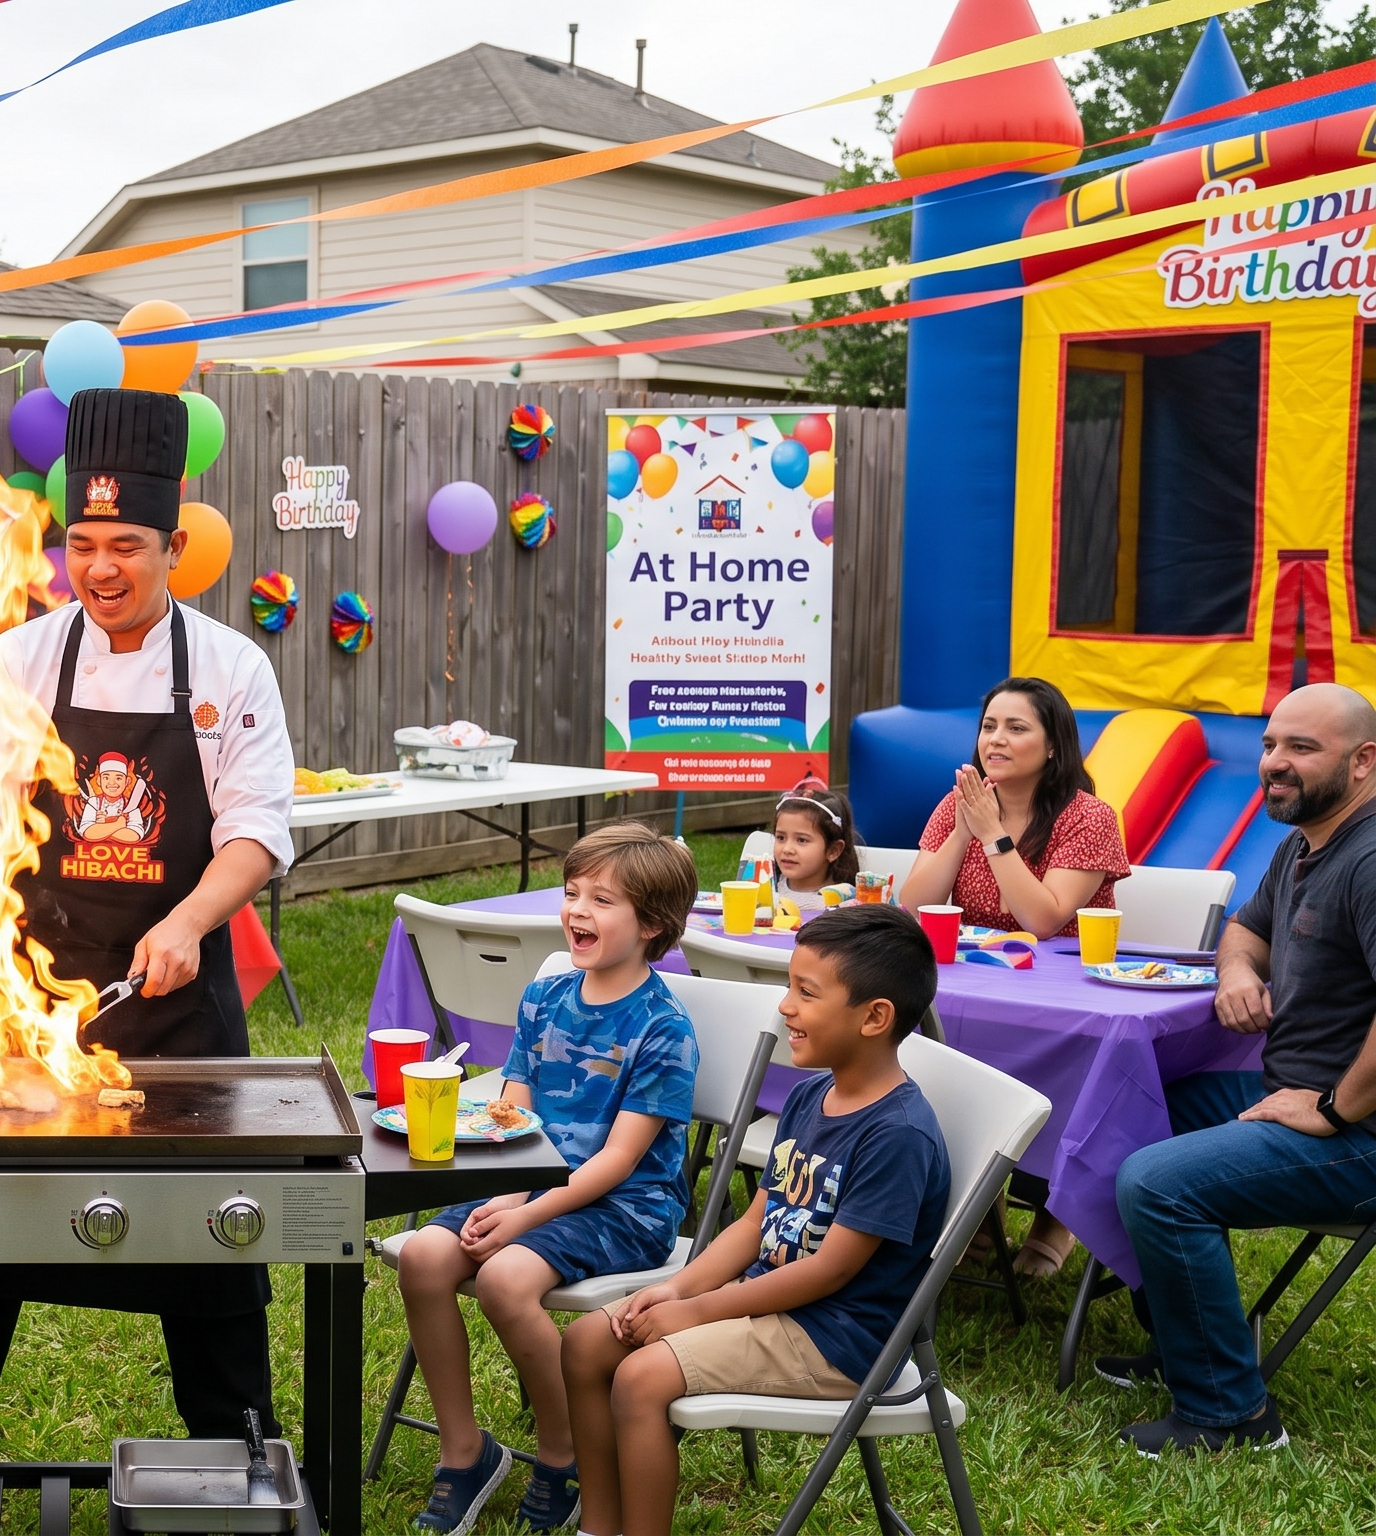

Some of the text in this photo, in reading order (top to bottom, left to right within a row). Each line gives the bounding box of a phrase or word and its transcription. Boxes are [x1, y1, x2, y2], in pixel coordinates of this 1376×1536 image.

[285, 460, 345, 501] Happy
[275, 495, 356, 535] Birthday
[629, 551, 810, 583] At Home
[664, 590, 775, 631] Party
[62, 859, 161, 880] HIBACHI
[77, 844, 149, 863] LOVE
